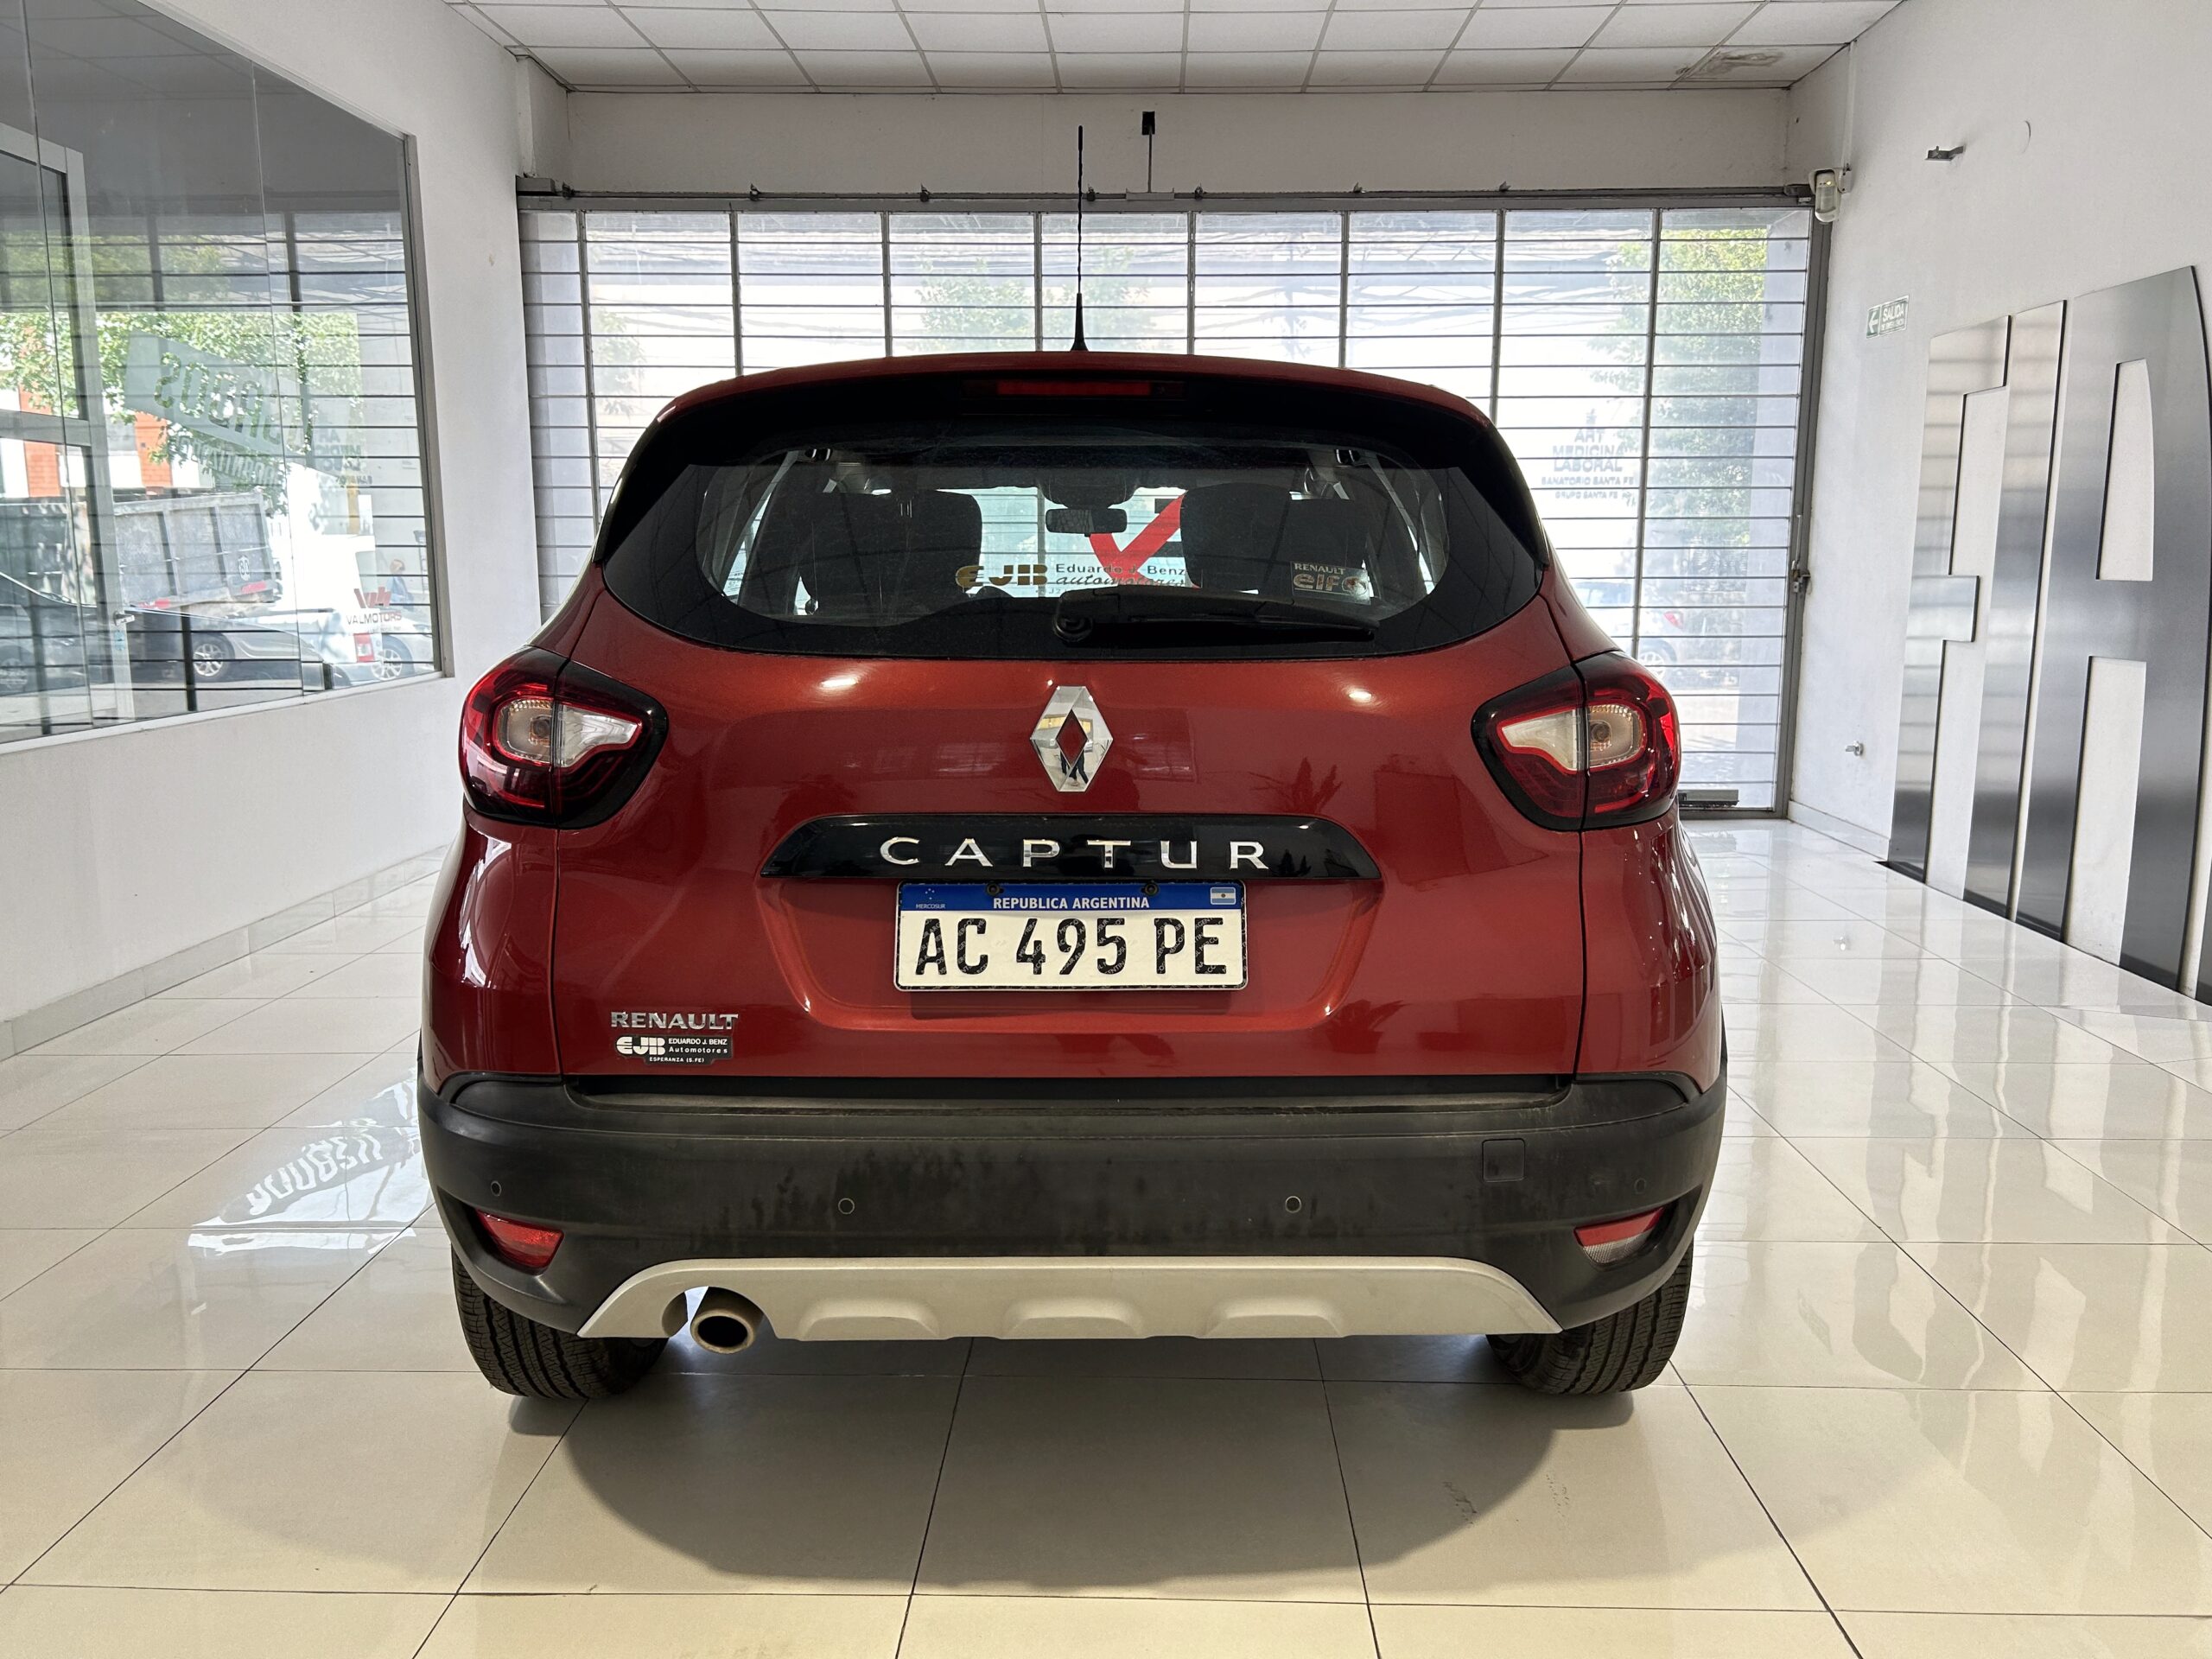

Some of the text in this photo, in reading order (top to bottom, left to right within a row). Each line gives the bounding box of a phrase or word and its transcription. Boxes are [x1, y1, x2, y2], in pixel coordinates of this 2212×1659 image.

[1882, 303, 1904, 323] SALIDA
[1574, 429, 1605, 443] ART
[1552, 444, 1625, 456] MEDICINA
[1553, 459, 1623, 473] LABORAL
[1541, 476, 1591, 486] SANATORIO
[1592, 476, 1621, 486] SANTA
[1554, 491, 1581, 499] GRUPO
[1583, 491, 1607, 499] SANTA
[1055, 563, 1123, 574] Eduardo
[1147, 564, 1186, 575] Benz
[1294, 563, 1346, 575] RENAULT
[1055, 573, 1186, 588] automotores
[1293, 573, 1340, 591] elf
[346, 610, 402, 626] VALMOTORS
[1888, 265, 2212, 1007] FIA
[880, 836, 1268, 870] CAPTUR
[993, 897, 1150, 909] REPUBLICA ARGENTINA
[915, 918, 1228, 976] AC 495 PE
[610, 1011, 739, 1030] RENAULT
[616, 1036, 666, 1055] EJB
[668, 1046, 728, 1054] Automotores
